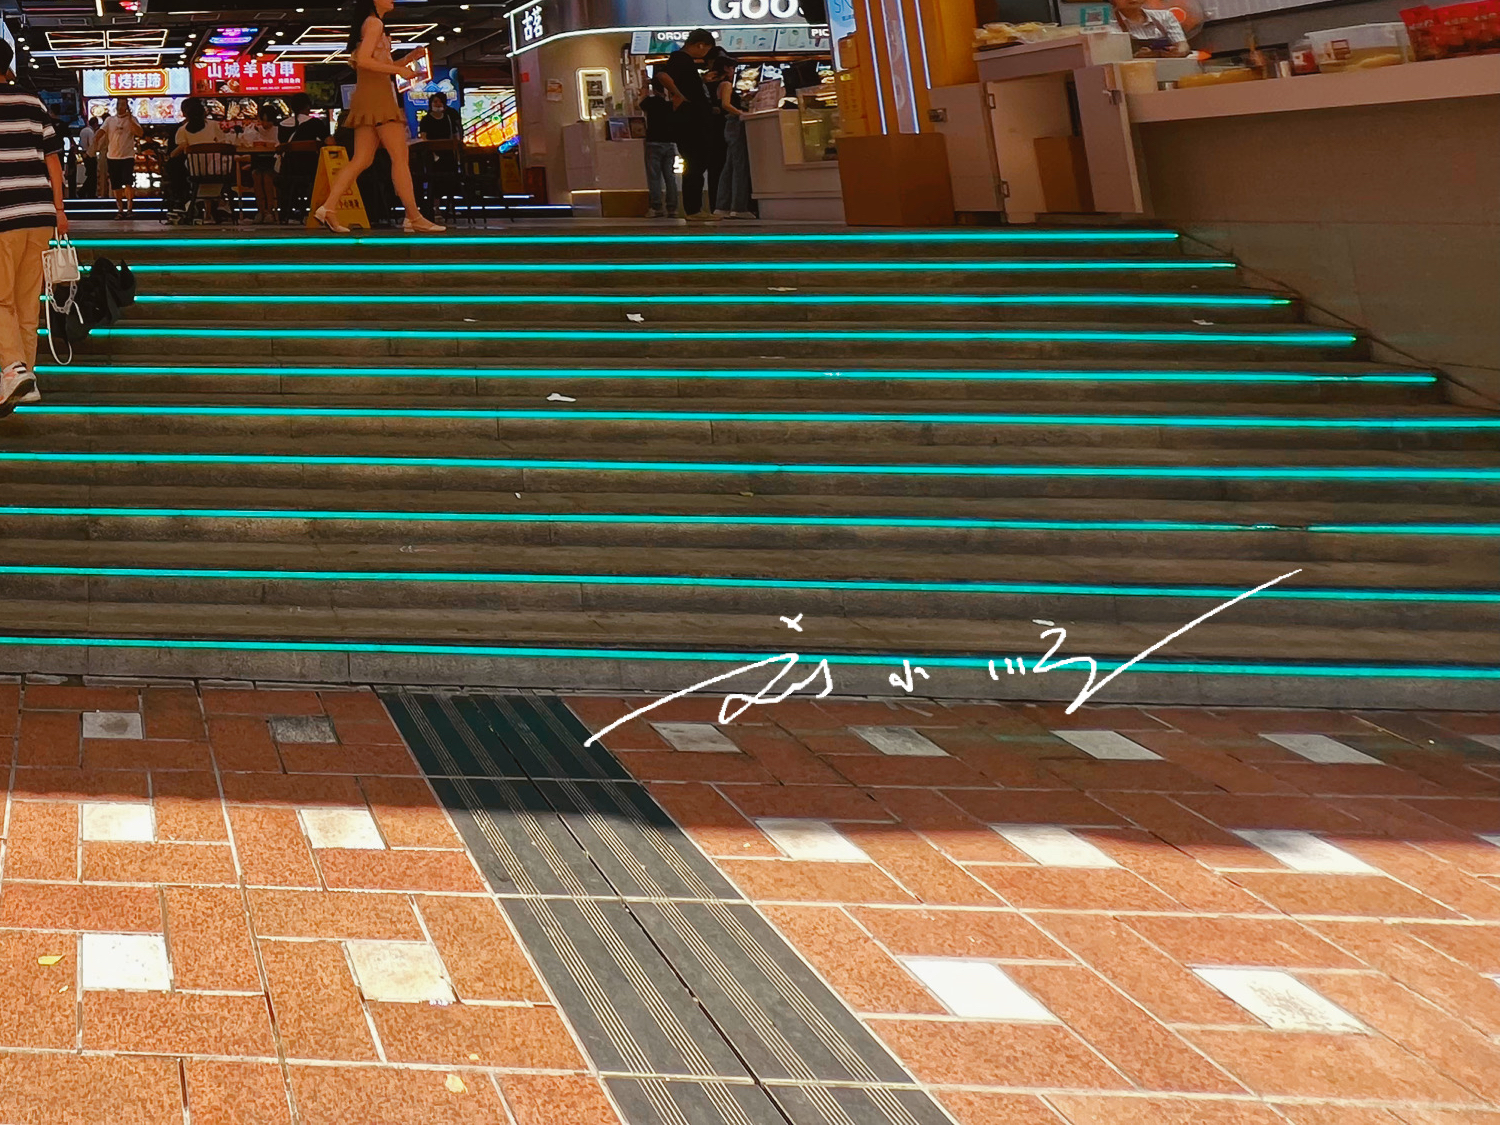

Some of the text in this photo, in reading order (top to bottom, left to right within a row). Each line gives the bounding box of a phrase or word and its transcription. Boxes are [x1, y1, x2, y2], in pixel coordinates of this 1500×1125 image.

[207, 61, 295, 79] 山城羊肉串
